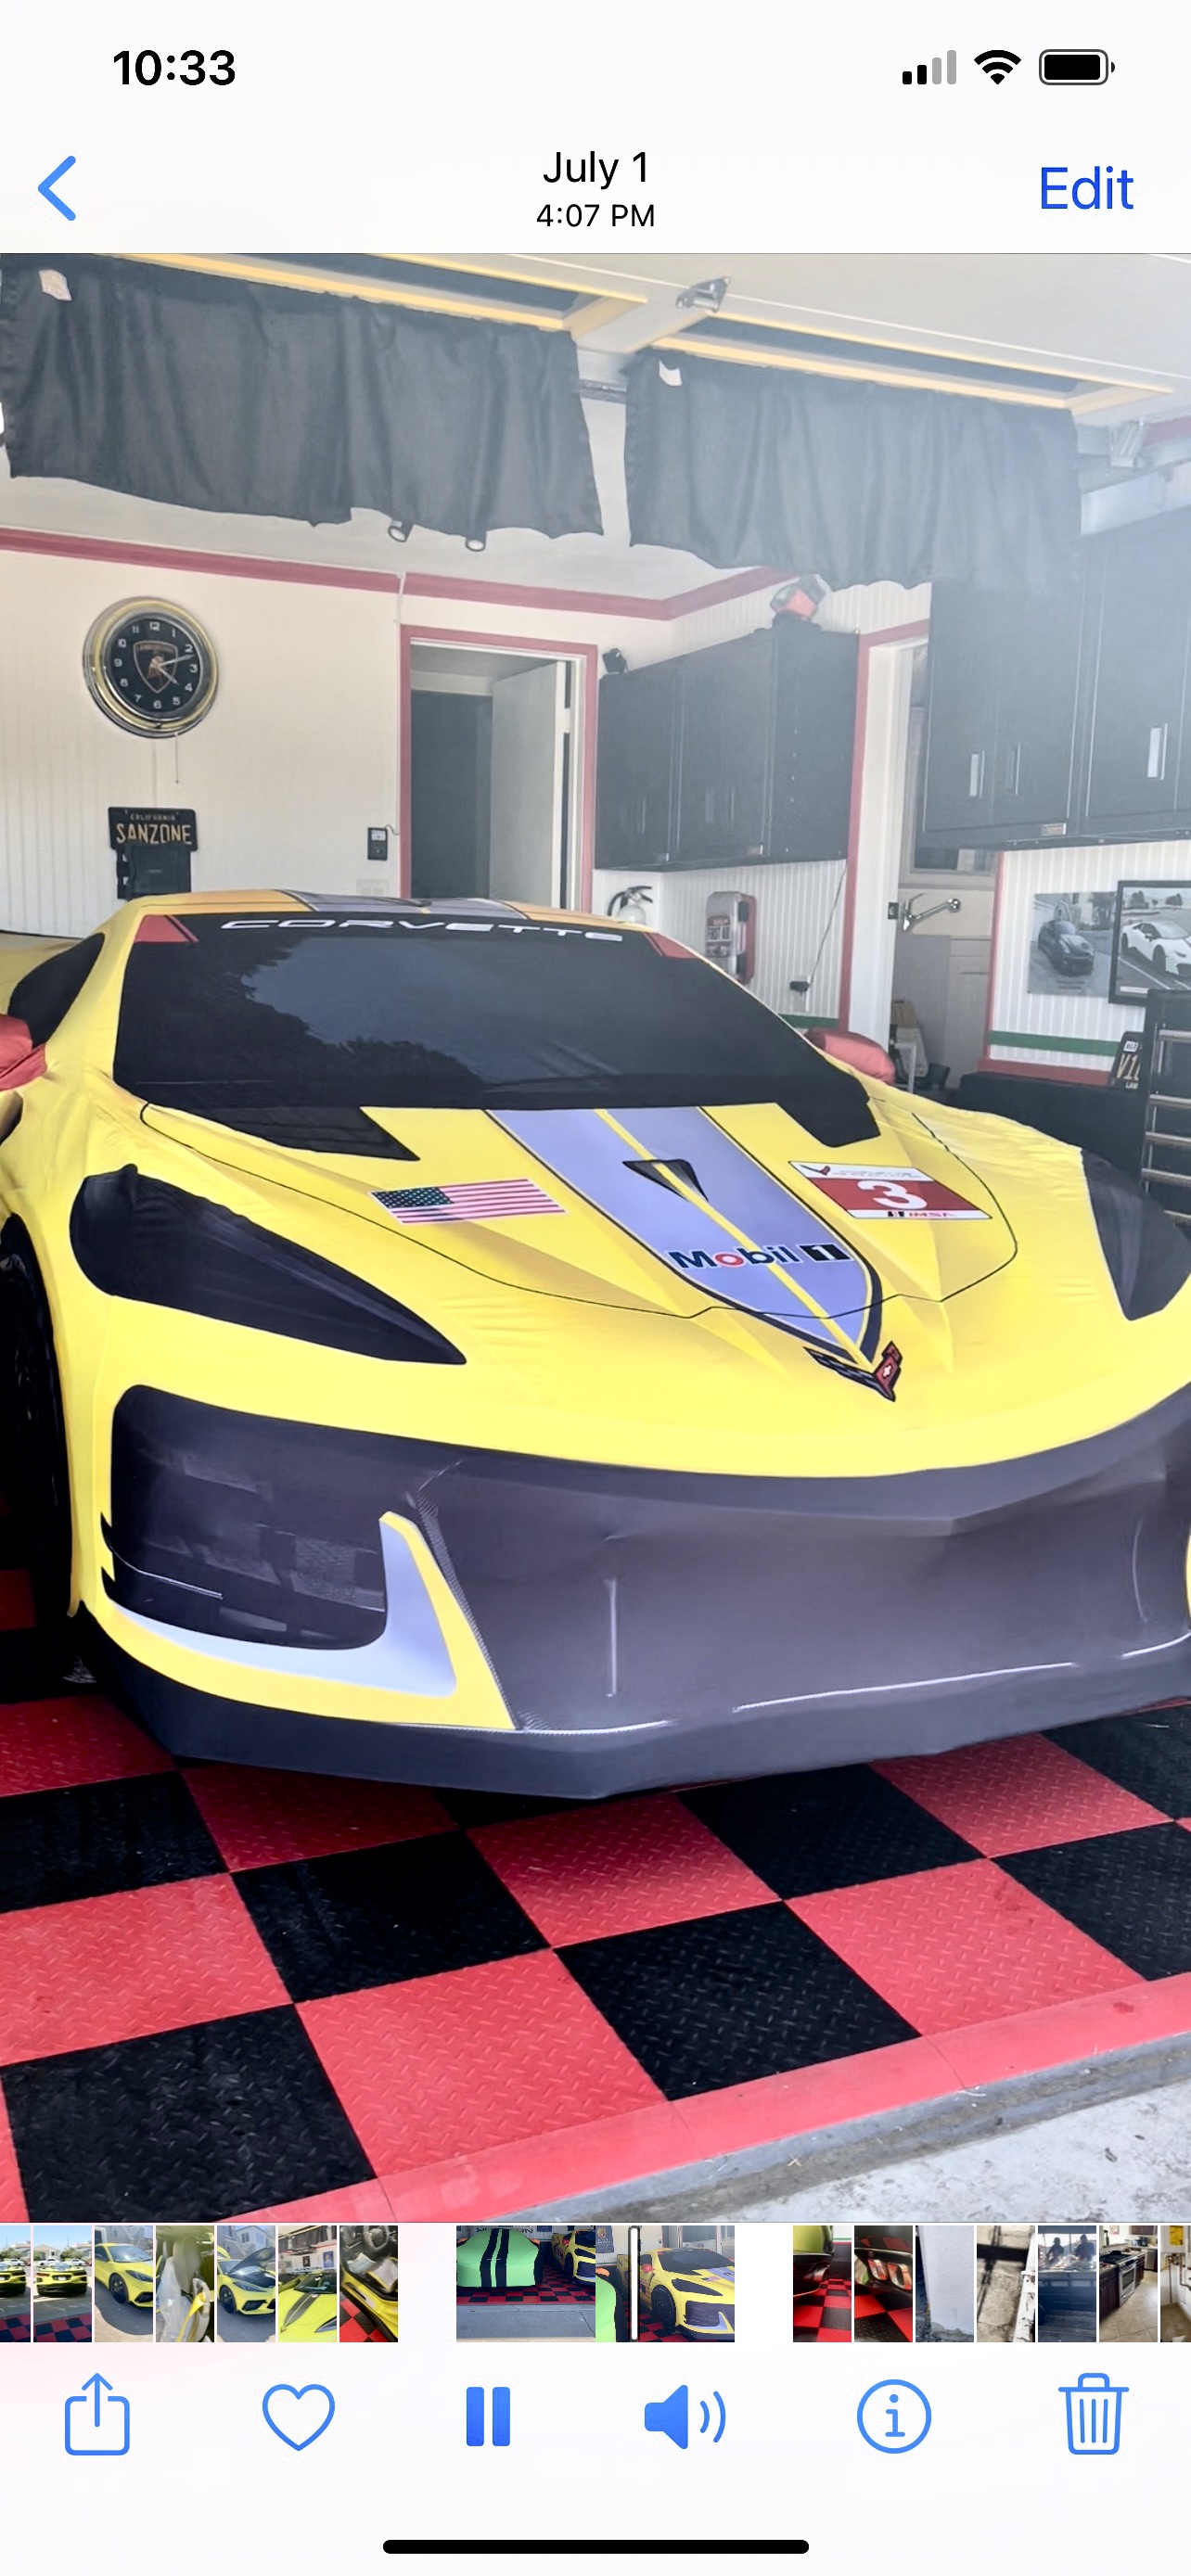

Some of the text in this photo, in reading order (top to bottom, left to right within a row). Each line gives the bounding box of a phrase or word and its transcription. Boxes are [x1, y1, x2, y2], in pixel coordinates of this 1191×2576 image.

[149, 622, 160, 631] 12
[185, 644, 194, 653] 2
[113, 658, 122, 667] 9
[189, 664, 198, 673] 3
[185, 682, 193, 692] 4
[134, 695, 142, 703] 7
[173, 696, 181, 706] 5
[153, 700, 162, 709] 6
[116, 823, 192, 845] SANZONE
[221, 918, 624, 942] CORVETTE
[857, 1180, 928, 1210] 3
[668, 1246, 801, 1269] Mobil
